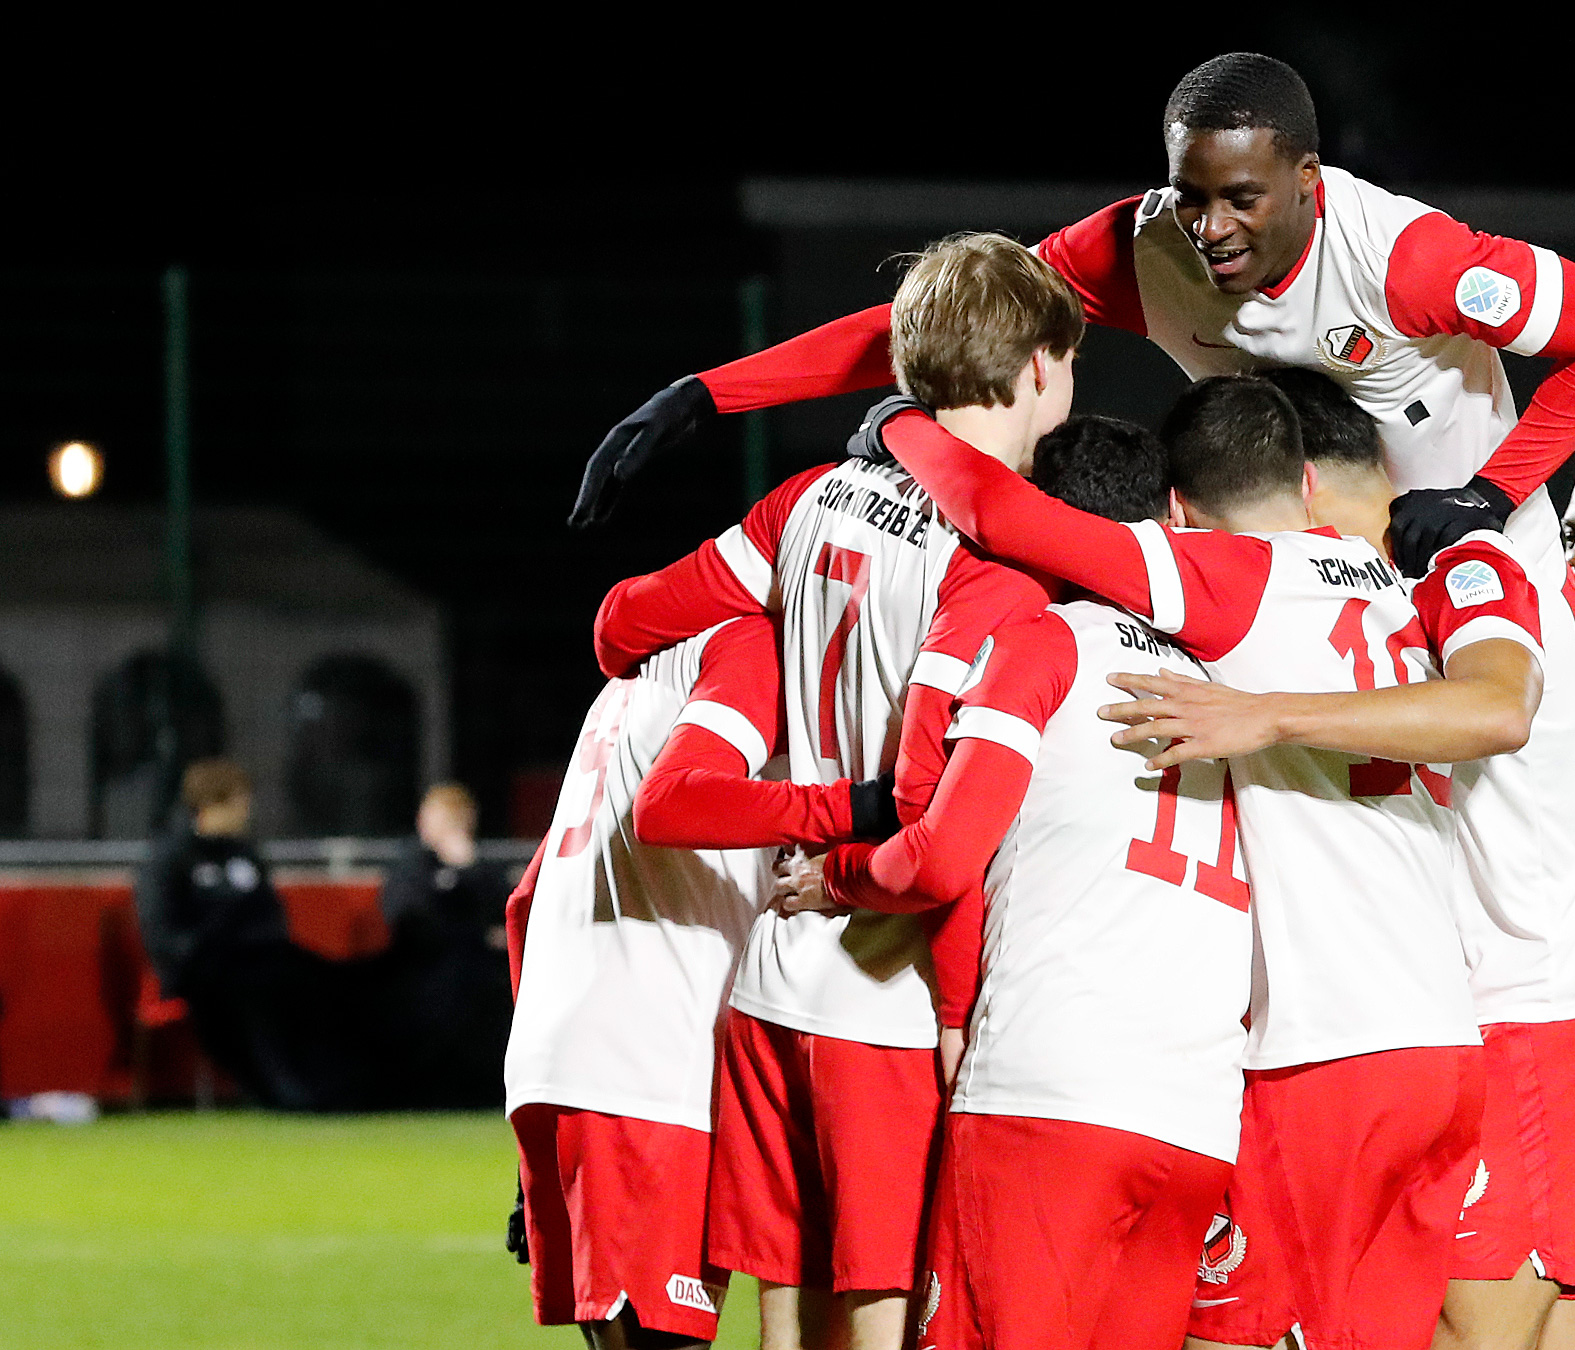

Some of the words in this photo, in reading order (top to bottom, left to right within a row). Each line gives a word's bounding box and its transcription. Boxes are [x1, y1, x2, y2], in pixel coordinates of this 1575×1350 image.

[1493, 284, 1513, 320] LINKIT
[1460, 589, 1495, 603] LINKIT
[814, 541, 872, 760] 7
